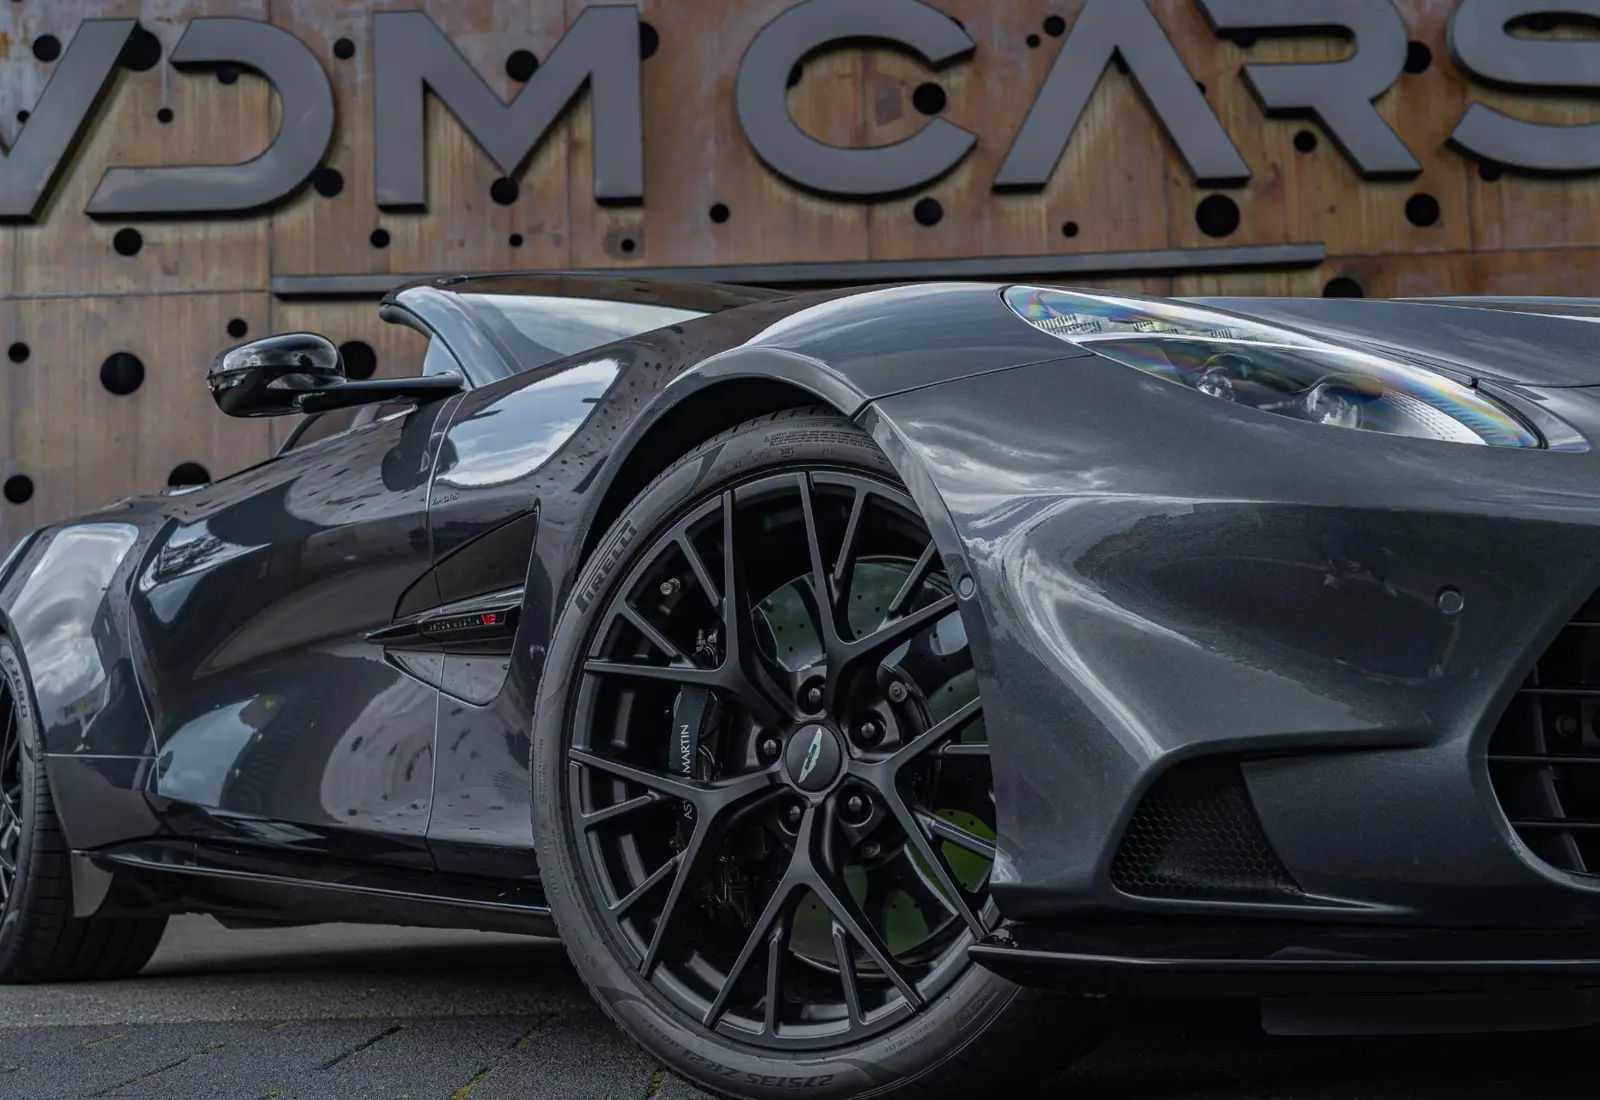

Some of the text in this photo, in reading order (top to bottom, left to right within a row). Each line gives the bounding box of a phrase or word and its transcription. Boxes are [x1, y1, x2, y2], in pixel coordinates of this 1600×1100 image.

[735, 0, 1600, 194] CARS
[574, 519, 638, 615] PIRELLI
[680, 724, 691, 773] MARTIN
